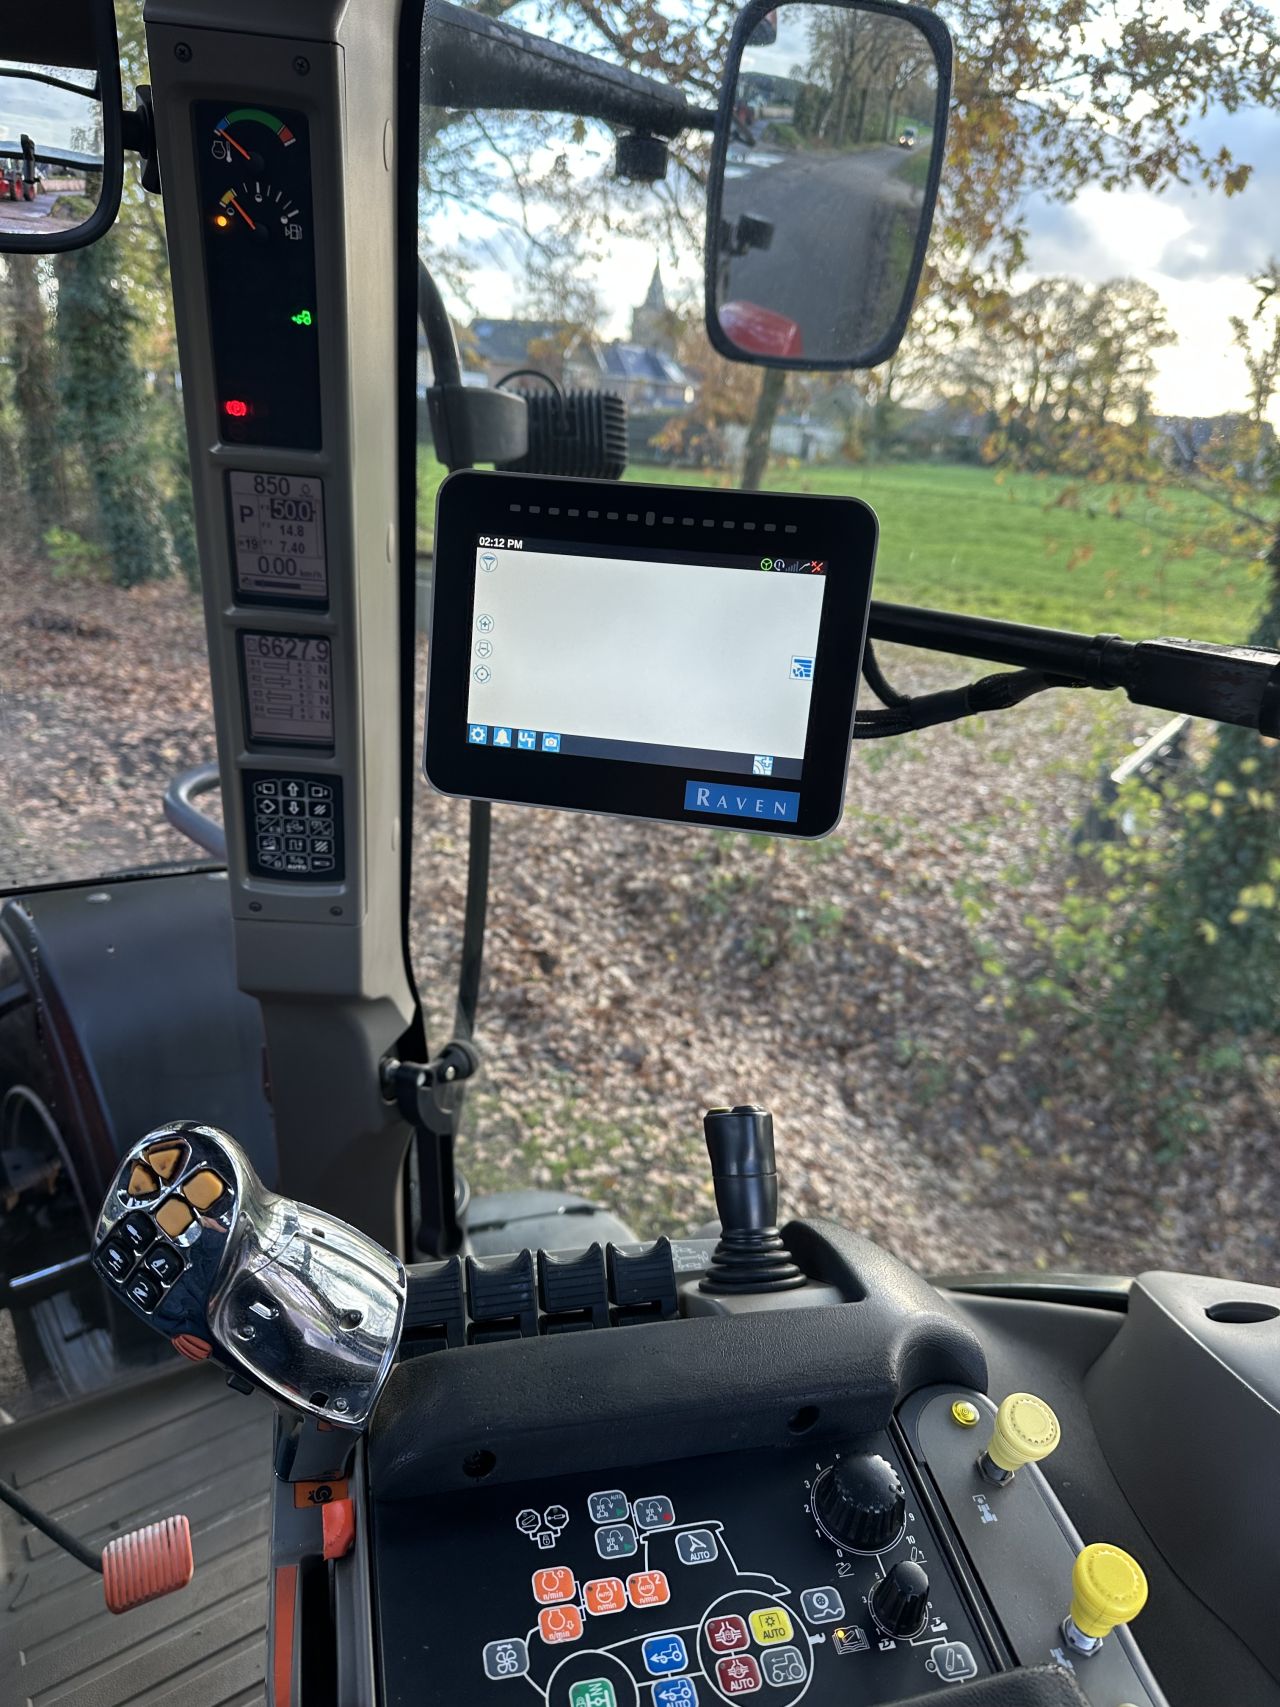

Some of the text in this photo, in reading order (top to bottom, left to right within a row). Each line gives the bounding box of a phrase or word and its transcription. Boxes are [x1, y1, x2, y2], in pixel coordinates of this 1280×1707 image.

[254, 475, 290, 496] 850
[240, 505, 254, 523] P
[280, 525, 305, 537] 14.8
[280, 541, 305, 554] 7.40
[479, 536, 523, 550] 02:12 PM
[258, 556, 297, 577] 0.00
[258, 636, 329, 661] 6627.9
[696, 787, 787, 816] RAVEN
[803, 1480, 810, 1489] 3
[803, 1504, 811, 1513] 2
[908, 1512, 915, 1522] 9
[815, 1529, 821, 1538] 1
[905, 1535, 916, 1545] 10
[690, 1550, 710, 1561] AUTO
[653, 1574, 661, 1584] 2
[611, 1581, 618, 1592] 1
[640, 1583, 654, 1591] AUTO
[543, 1590, 564, 1601] n/min
[861, 1595, 868, 1604] 3
[763, 1627, 786, 1640] AUTO
[730, 1677, 755, 1691] AUTO
